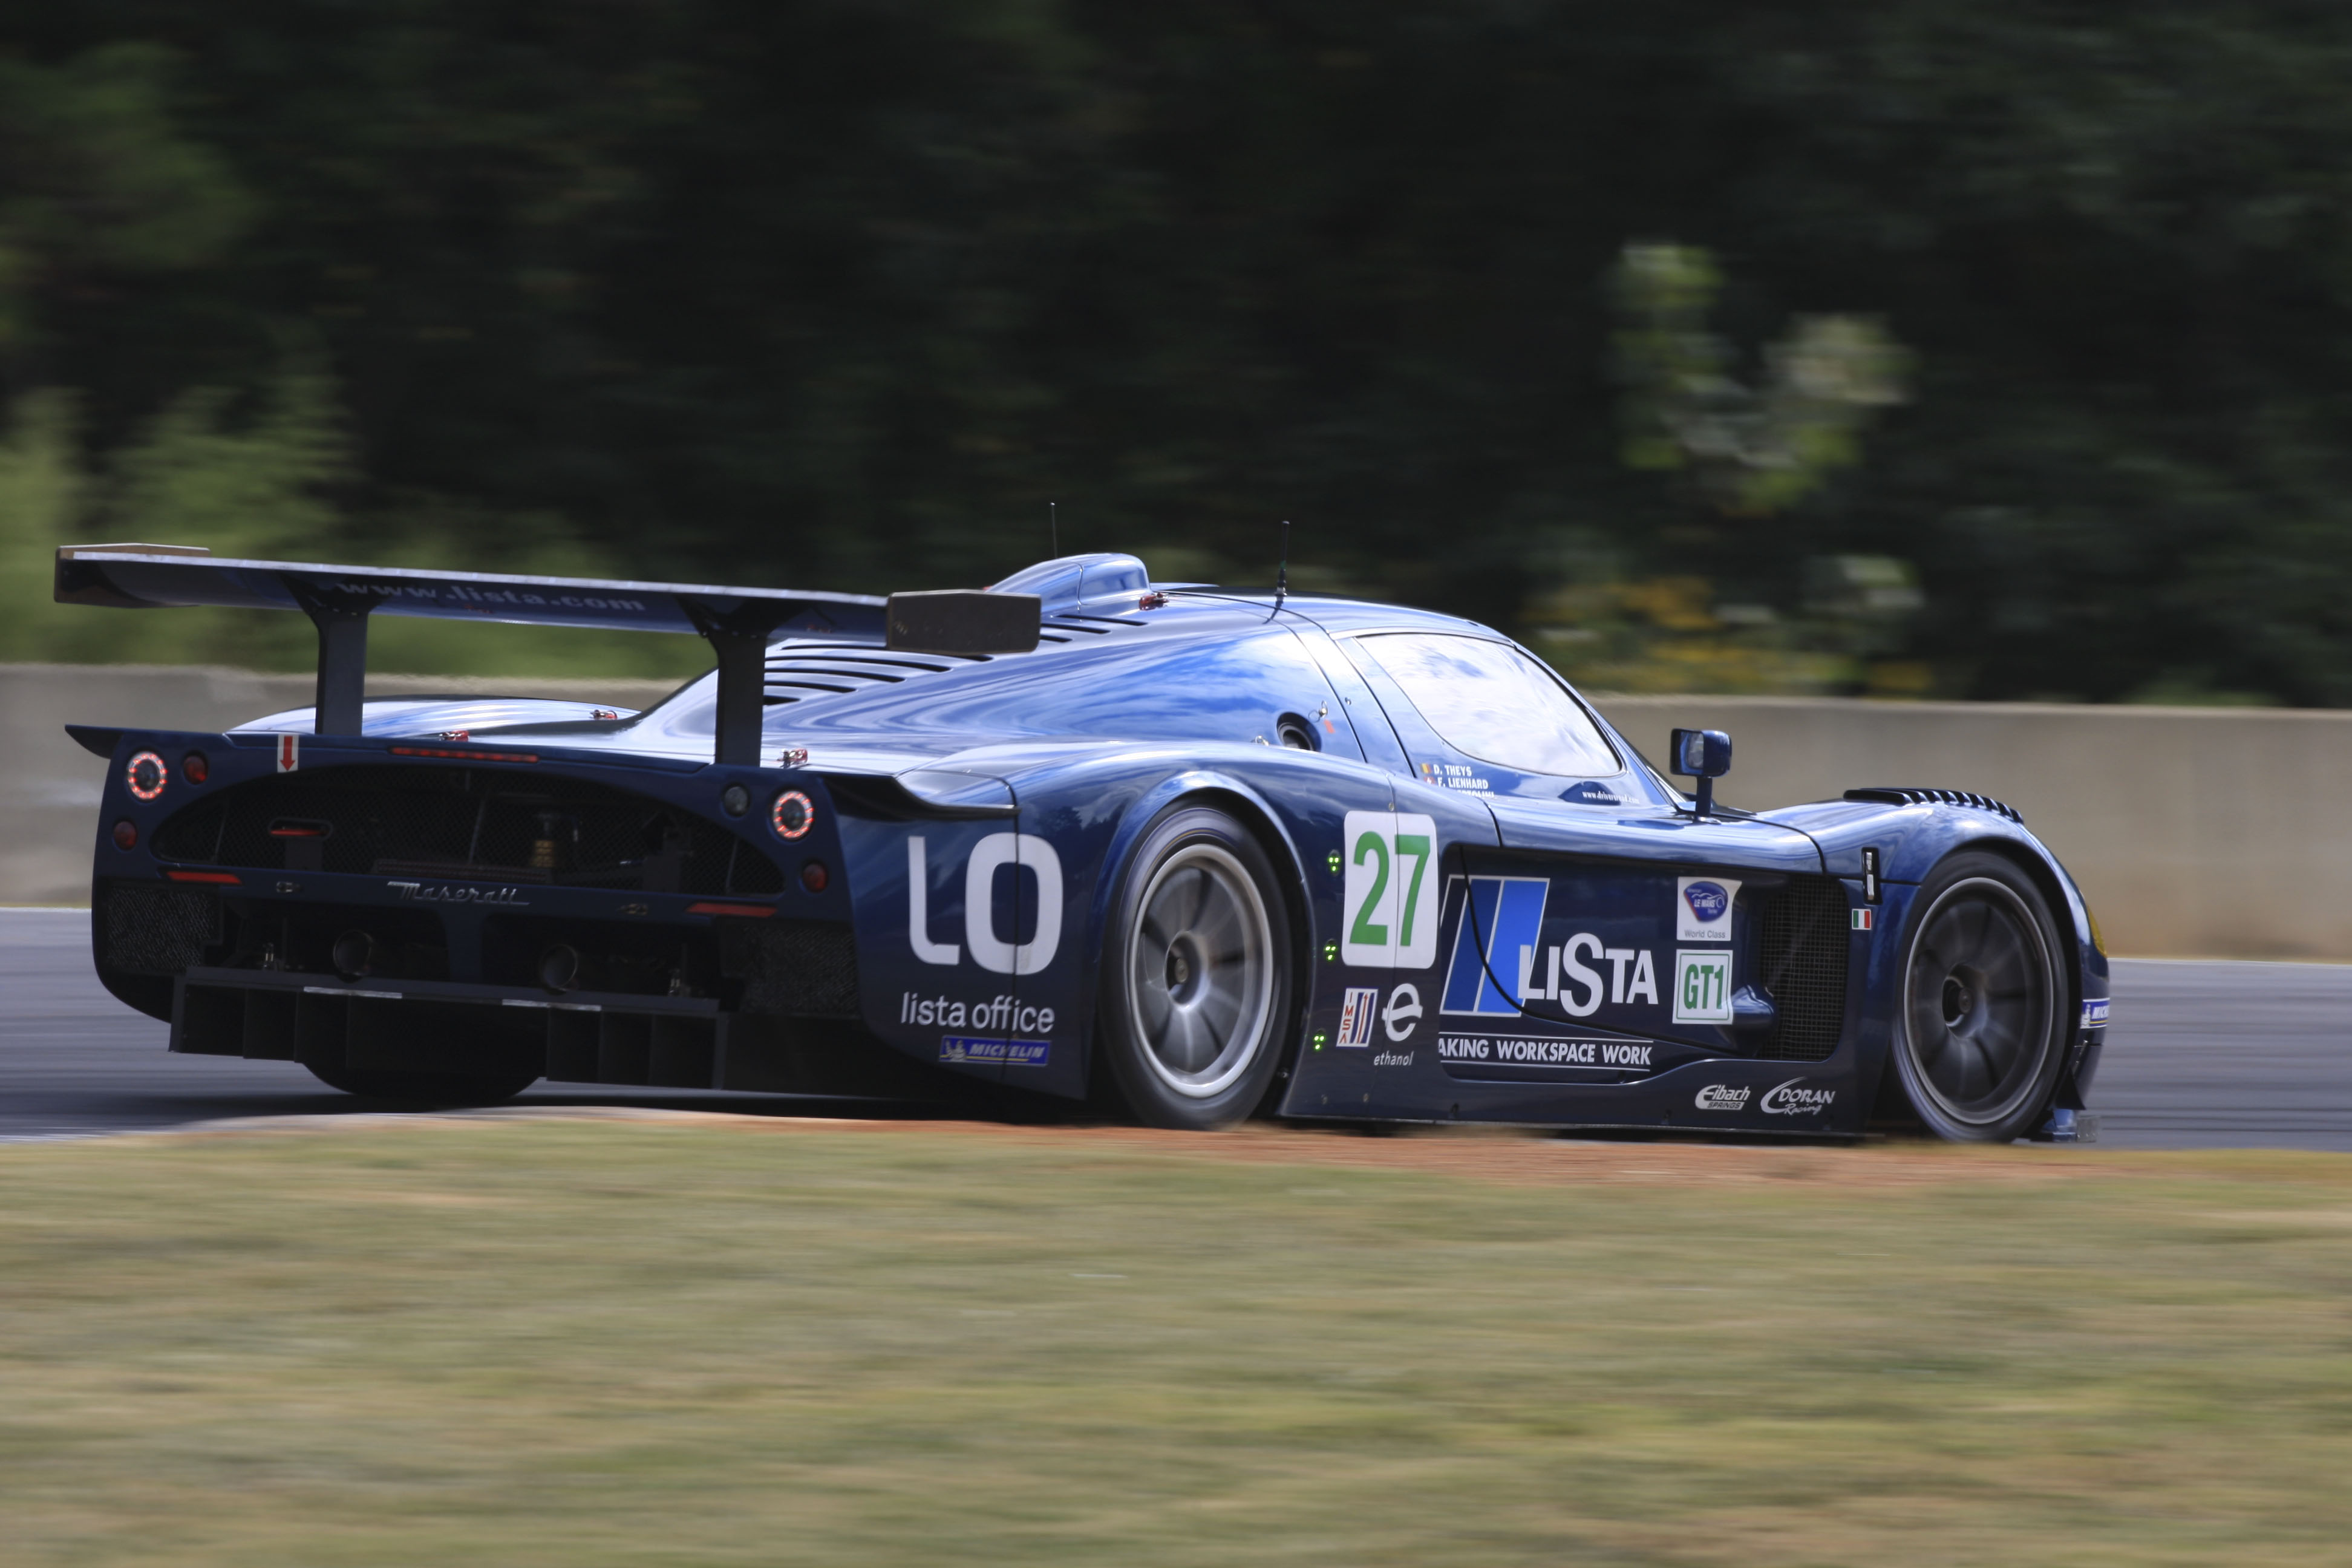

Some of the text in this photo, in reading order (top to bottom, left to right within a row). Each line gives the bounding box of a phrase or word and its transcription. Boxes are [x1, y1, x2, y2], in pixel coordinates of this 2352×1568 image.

[336, 581, 646, 611] www.lista.com
[1433, 764, 1472, 777] D. THEYS
[1448, 777, 1489, 789] LIENHARD
[387, 881, 530, 905] Maserati
[1350, 831, 1431, 947] 27
[907, 832, 1063, 976] LO
[1684, 929, 1726, 939] World Class
[1518, 932, 1659, 1016] LISTA
[1684, 964, 1724, 1010] GT1
[900, 991, 1055, 1033] lista office
[1339, 991, 1354, 1044] IMSA
[969, 1044, 1045, 1058] MICHELIN
[1373, 1050, 1414, 1066] ethanol
[1497, 1040, 1596, 1063] WORKSPACE
[1602, 1045, 1653, 1065] WORK
[1695, 1084, 1751, 1106] Eibach
[1779, 1088, 1836, 1104] DORAN
[1785, 1103, 1822, 1115] Racing
